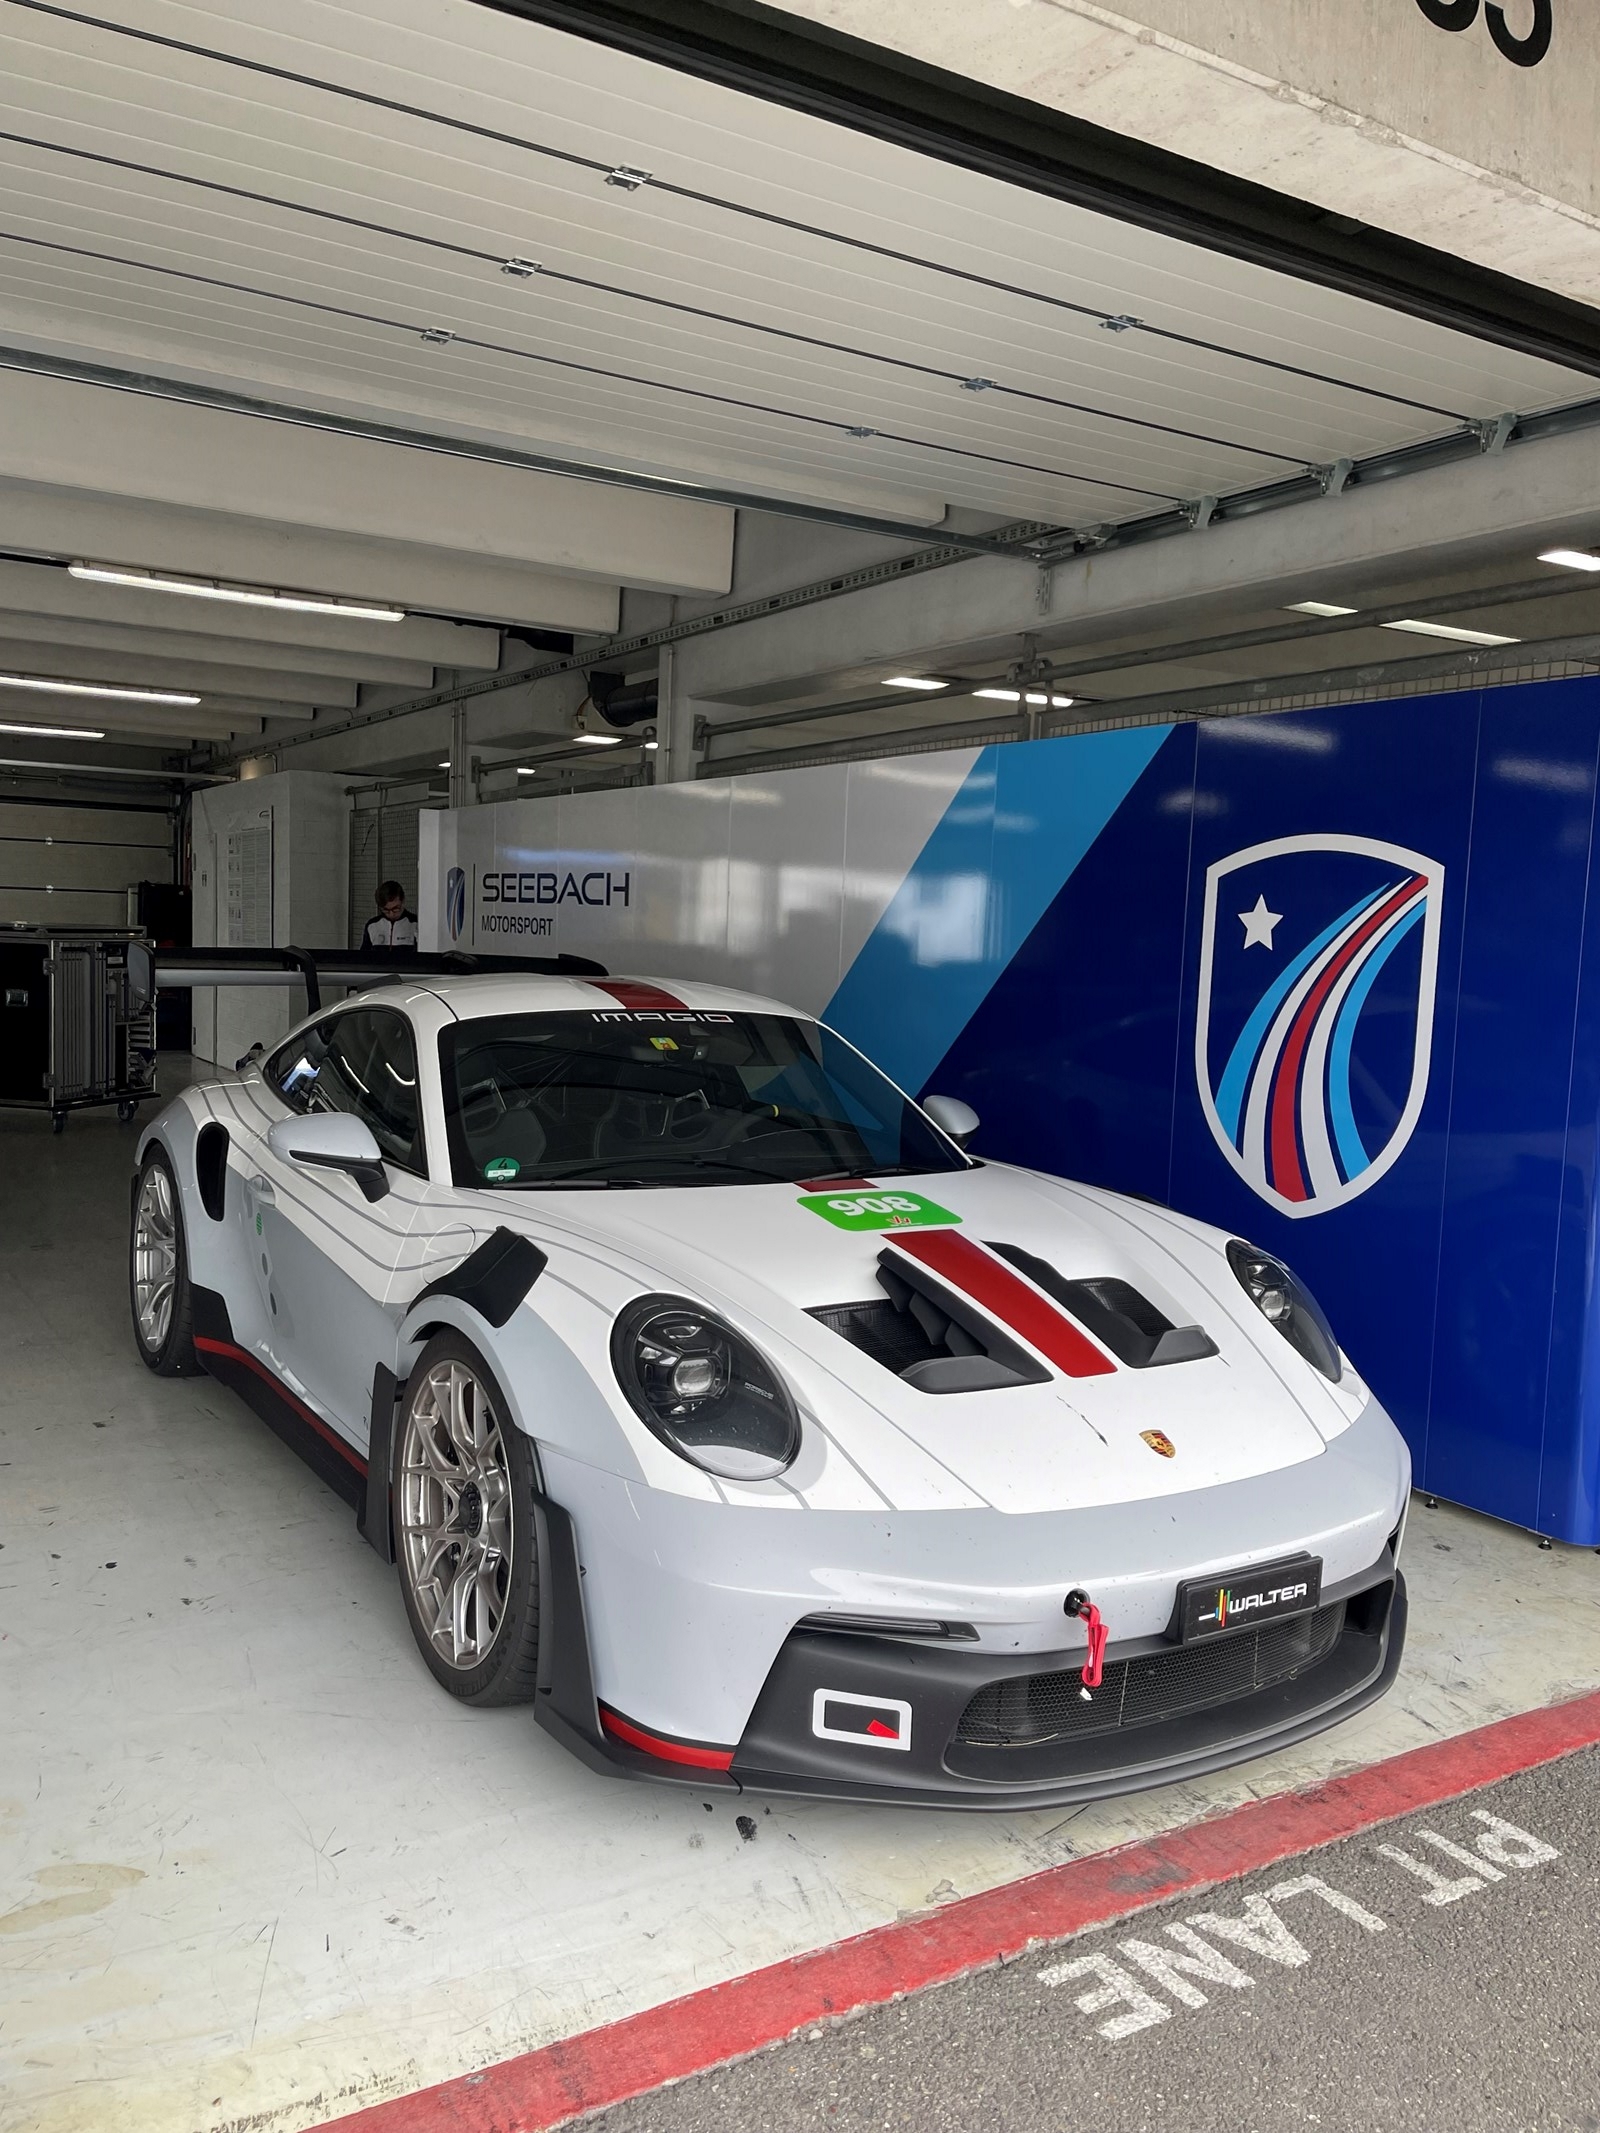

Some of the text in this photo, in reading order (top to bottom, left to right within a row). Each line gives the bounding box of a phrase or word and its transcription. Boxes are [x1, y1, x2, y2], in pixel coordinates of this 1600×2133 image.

[482, 872, 630, 907] SEEBACH
[481, 915, 554, 936] MOTORSPORT
[591, 1012, 735, 1024] IMAGIO
[498, 1158, 507, 1169] 4
[827, 1196, 922, 1217] 908
[1229, 1582, 1308, 1614] WALTER
[1036, 1808, 1562, 2041] PIT LANE
